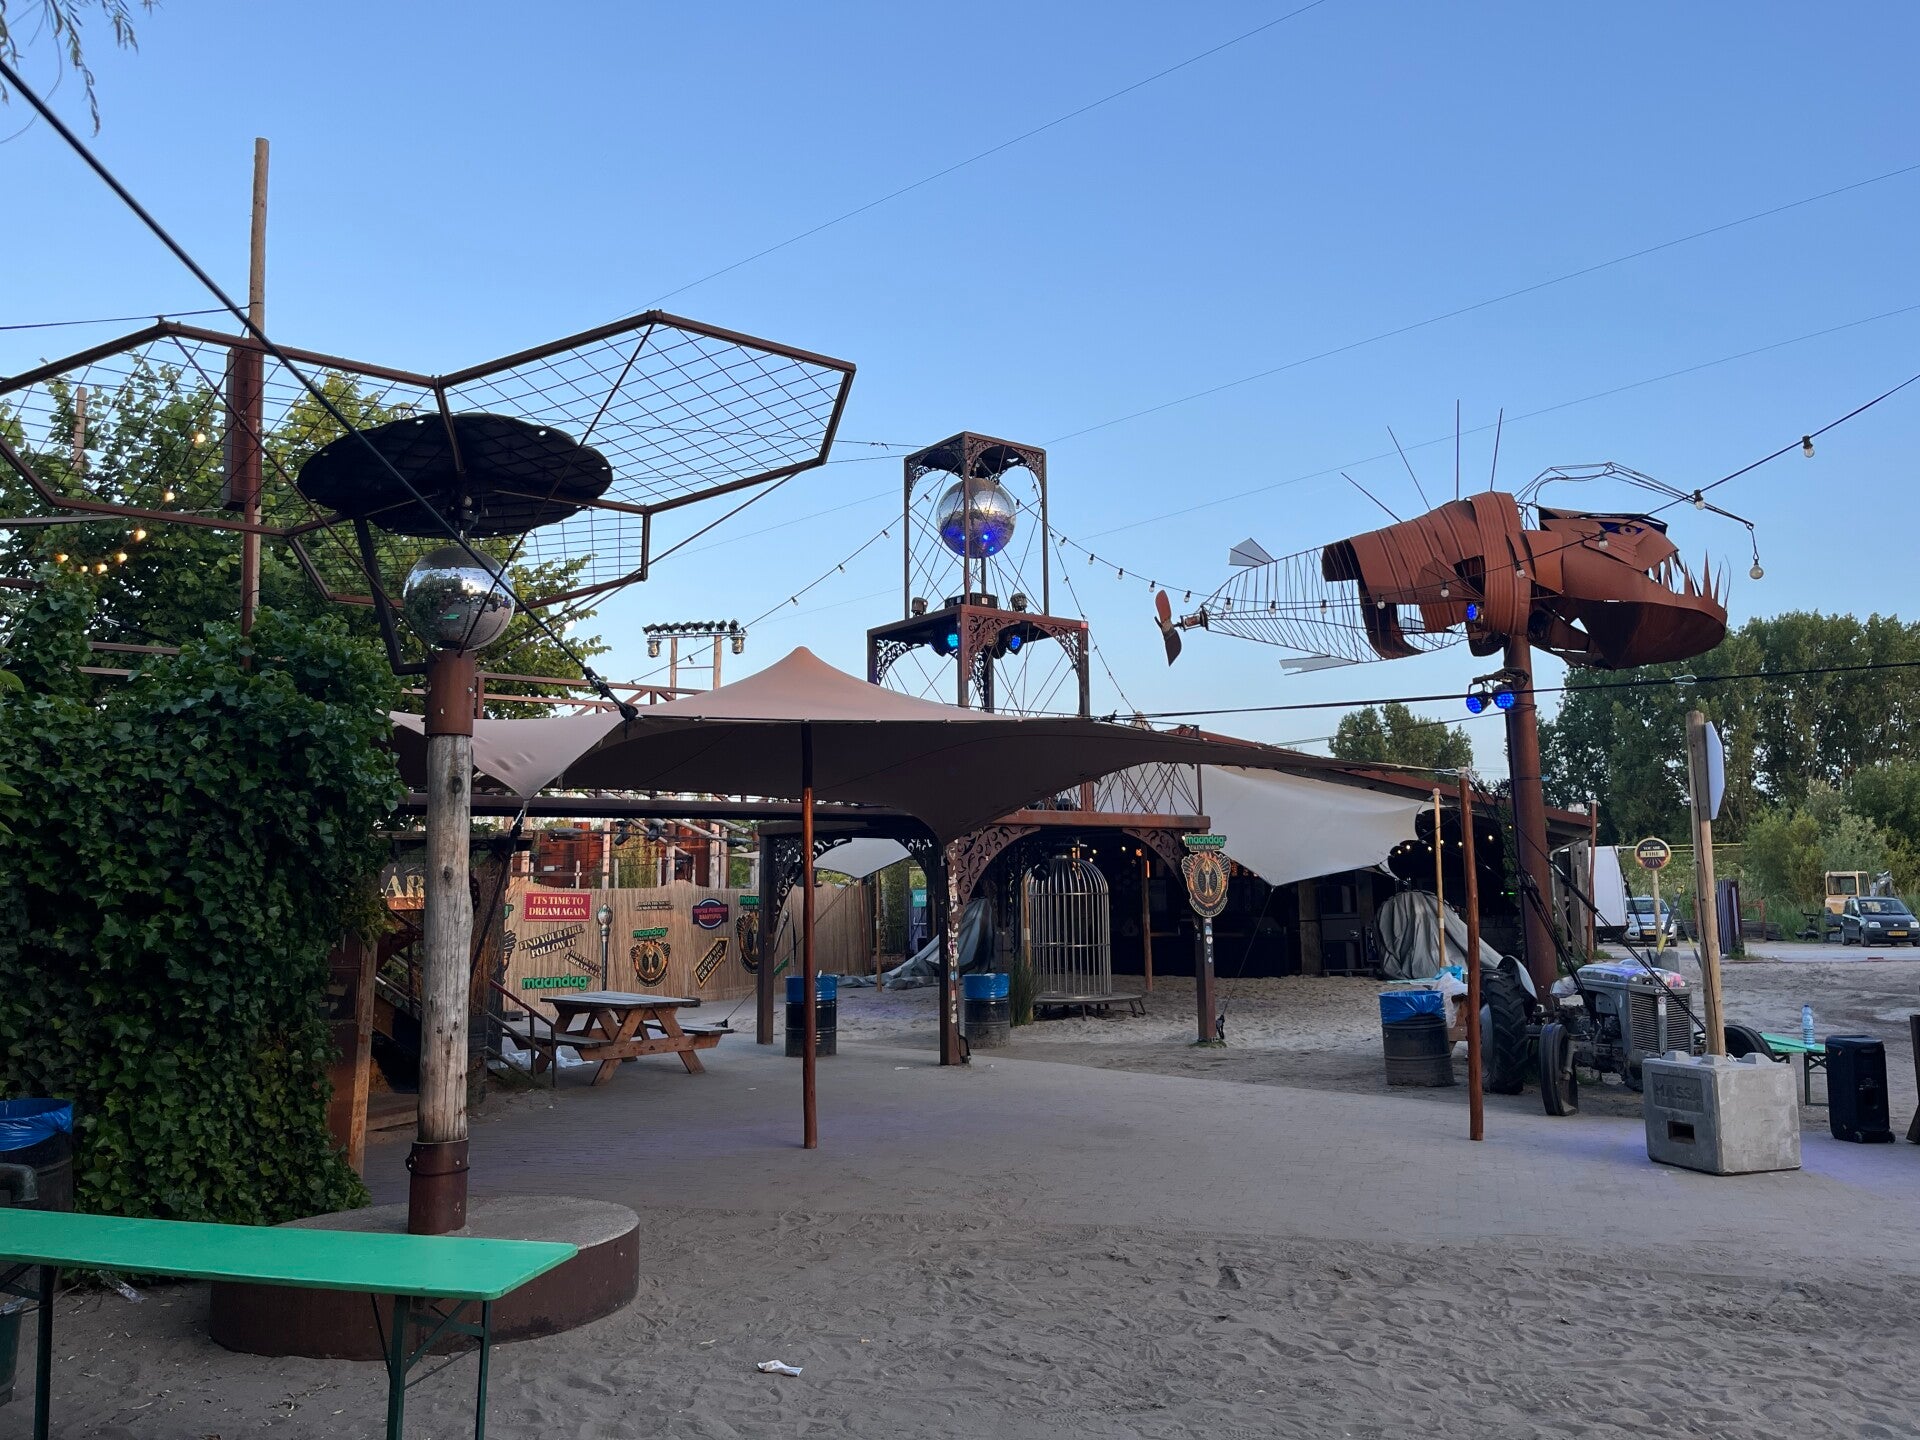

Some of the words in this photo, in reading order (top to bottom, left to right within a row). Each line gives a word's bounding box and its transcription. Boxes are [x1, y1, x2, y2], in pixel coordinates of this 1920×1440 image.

[1186, 835, 1224, 847] maandag
[548, 896, 570, 905] TIME
[571, 896, 584, 905] TO
[528, 907, 560, 916] DREAM
[561, 907, 587, 916] AGAIN
[519, 937, 540, 950] FIND
[539, 929, 563, 944] YOUR
[530, 940, 566, 958] FOLLOW
[566, 938, 577, 947] IT
[522, 974, 587, 990] maandag
